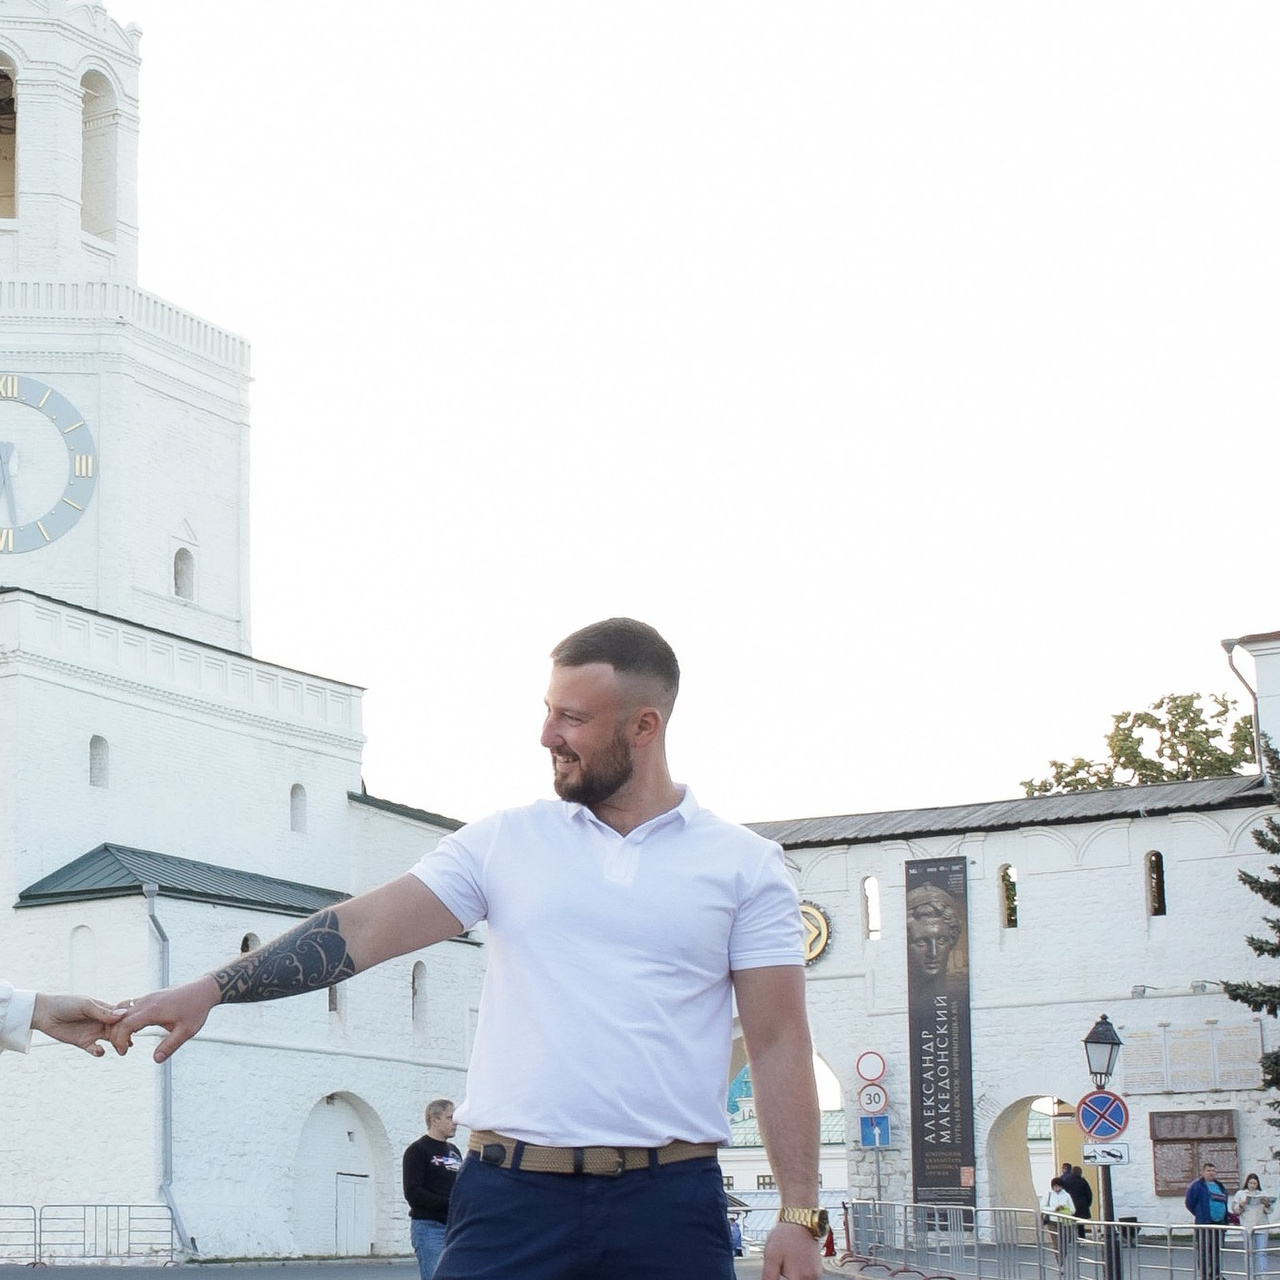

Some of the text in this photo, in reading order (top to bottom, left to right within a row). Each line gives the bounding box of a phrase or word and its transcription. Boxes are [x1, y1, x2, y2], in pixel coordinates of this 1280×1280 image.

[75, 454, 93, 478] III
[865, 1092, 881, 1105] 30
[921, 1030, 936, 1144] АЛЕКСАНДР
[933, 995, 951, 1143] МАКЕДОНСКИЙ
